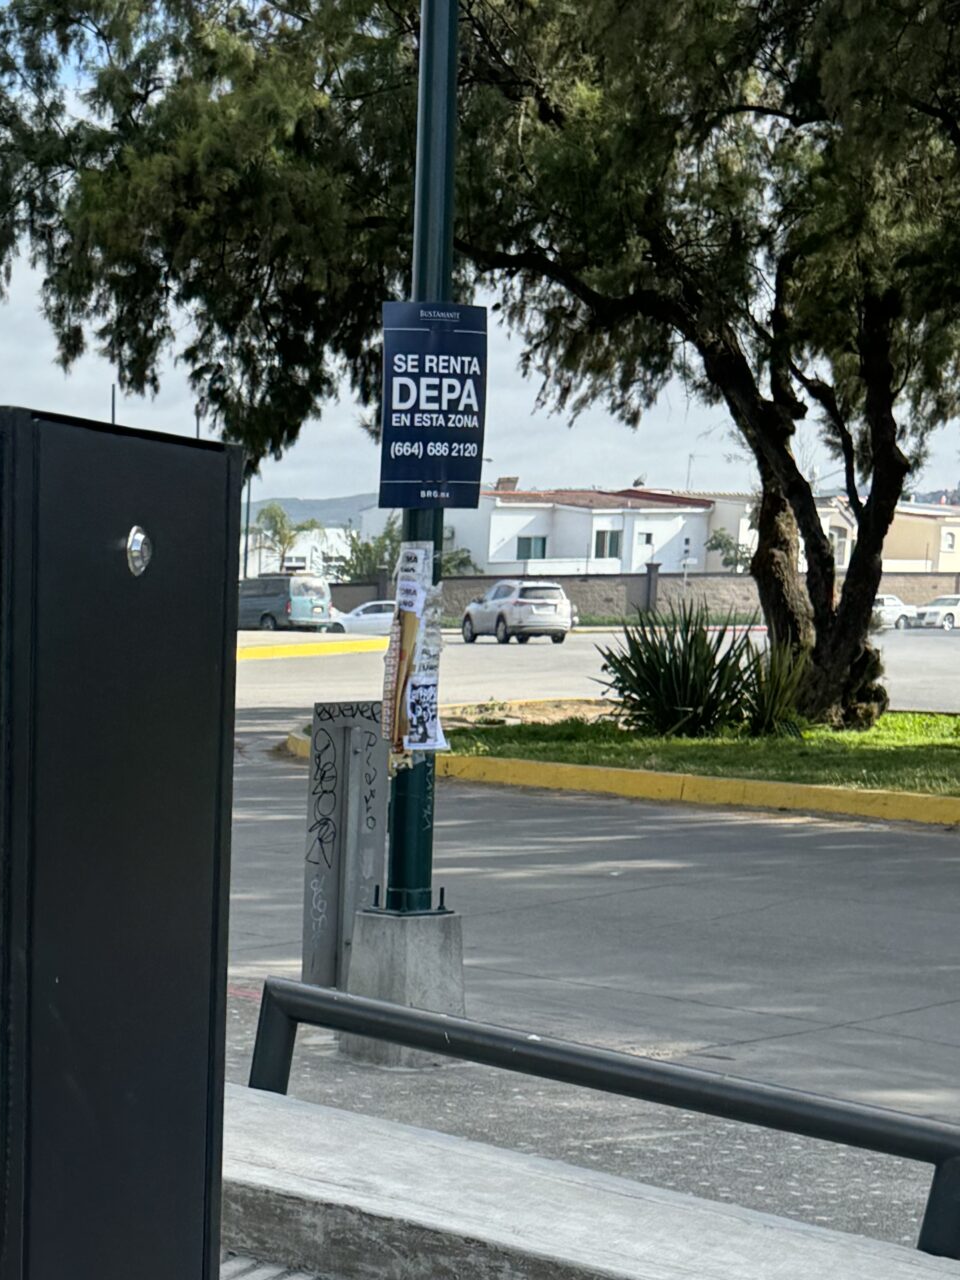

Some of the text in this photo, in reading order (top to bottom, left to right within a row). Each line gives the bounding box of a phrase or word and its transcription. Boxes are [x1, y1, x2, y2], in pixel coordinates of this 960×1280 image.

[393, 353, 481, 375] SE RENTA
[391, 376, 480, 412] DEPA
[391, 413, 479, 428] EN ESTA ZONA
[390, 440, 478, 459] (664) 686 2120
